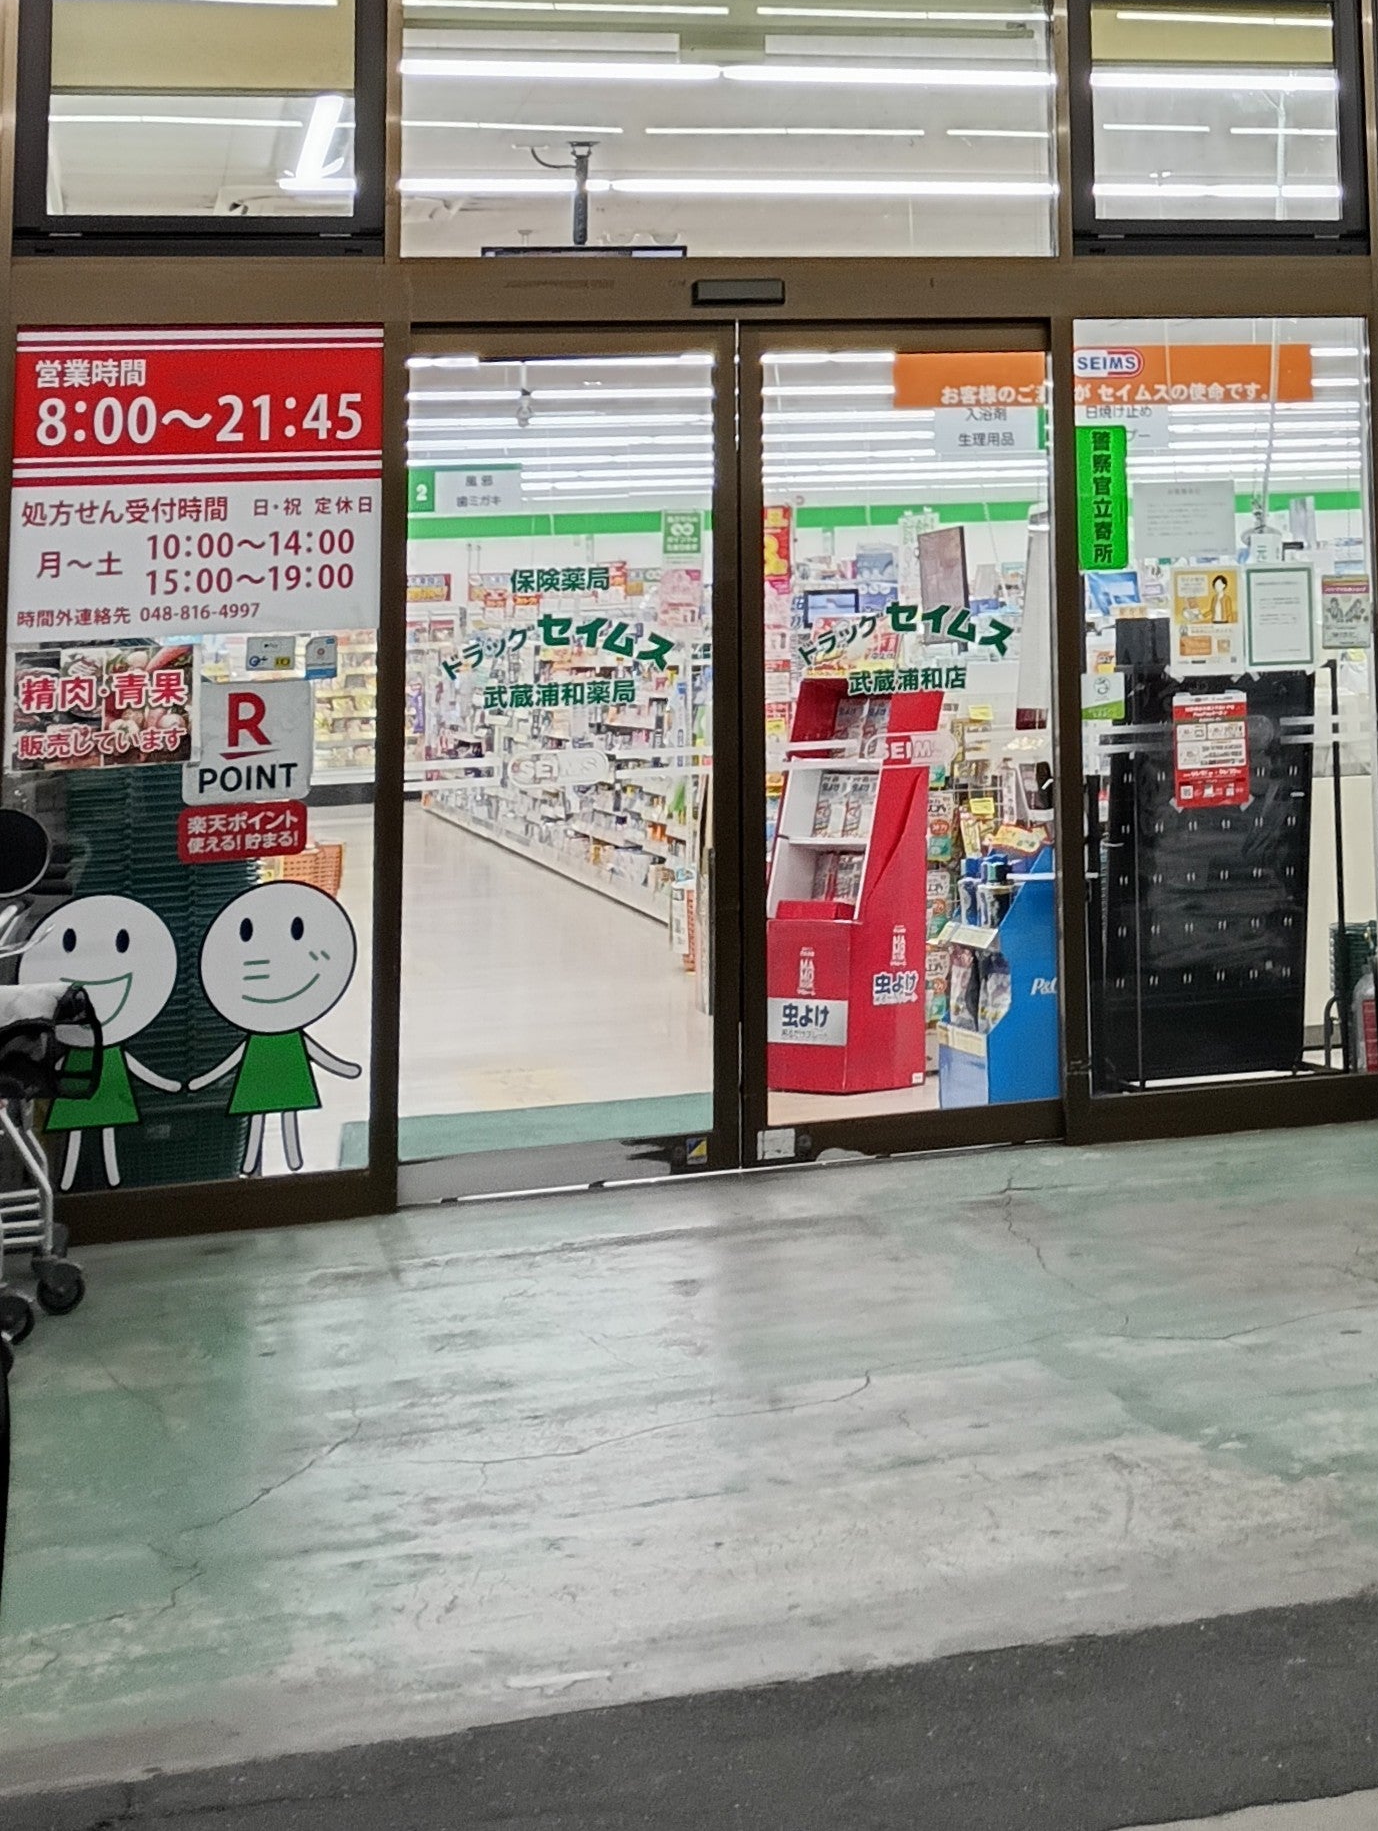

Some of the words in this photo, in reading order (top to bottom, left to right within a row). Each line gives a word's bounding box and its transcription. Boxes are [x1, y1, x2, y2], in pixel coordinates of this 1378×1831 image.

[36, 359, 147, 389] 営業時間
[1077, 356, 1136, 371] SEIMS
[966, 406, 1007, 421] 入浴剤
[1086, 404, 1152, 419] 日焼け止め
[958, 432, 1015, 447] 生理用品
[416, 484, 427, 501] 2
[1091, 431, 1114, 564] 警察官立寄所
[21, 497, 228, 527] 処方せん受付時間
[253, 498, 302, 516] 日・祝
[314, 496, 373, 515] 定休日
[510, 567, 610, 593] 保険薬局
[16, 607, 131, 628] 時間外連絡先
[139, 602, 261, 623] 048-816-4997
[19, 670, 189, 713] 精肉・青果
[849, 667, 966, 695] 武蔵浦和店
[483, 680, 635, 709] 武蔵浦和薬局
[227, 691, 272, 747] R
[18, 726, 187, 759] 販売しています
[198, 762, 298, 794] POINT
[187, 810, 298, 835] 楽天ポイント
[875, 973, 917, 994] 虫よけ
[782, 1003, 829, 1027] 虫よけ
